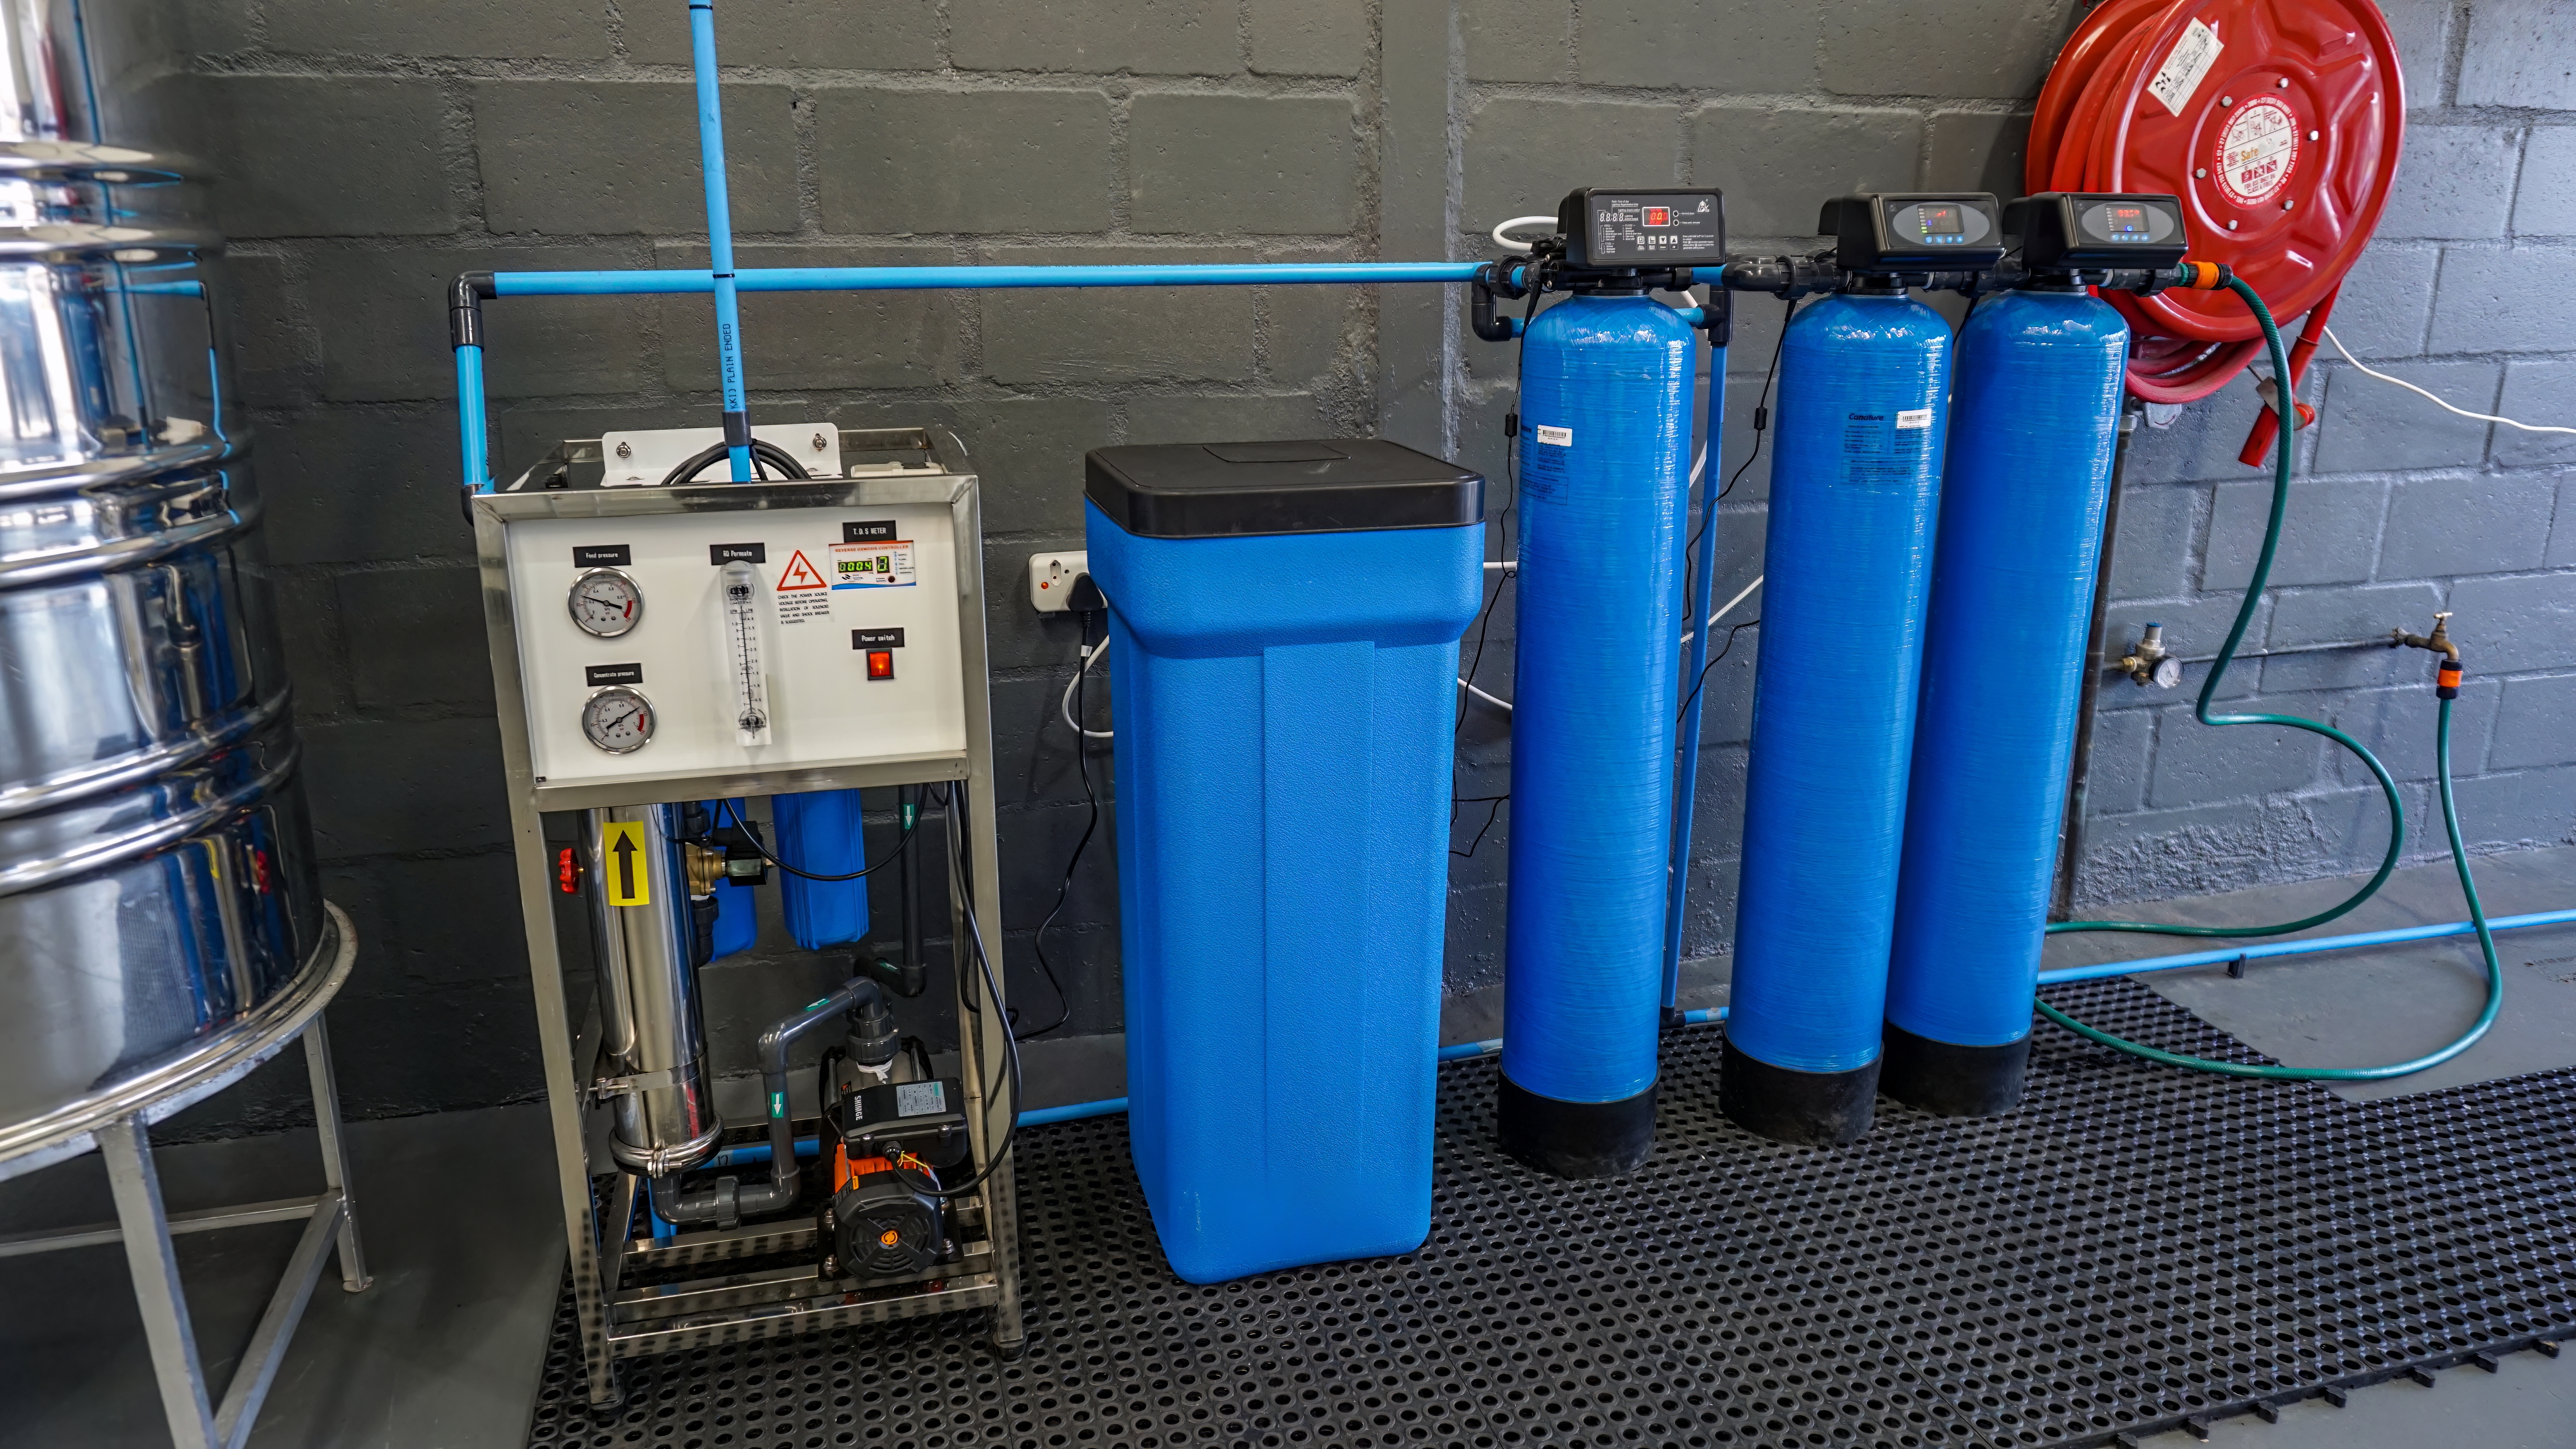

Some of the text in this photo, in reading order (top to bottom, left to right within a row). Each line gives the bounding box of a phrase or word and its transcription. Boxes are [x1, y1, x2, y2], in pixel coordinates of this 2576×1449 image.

[723, 324, 732, 351] ENDED
[726, 356, 735, 383] PLAIN
[839, 561, 872, 572] 0004
[854, 1095, 863, 1121] SHIMGE
